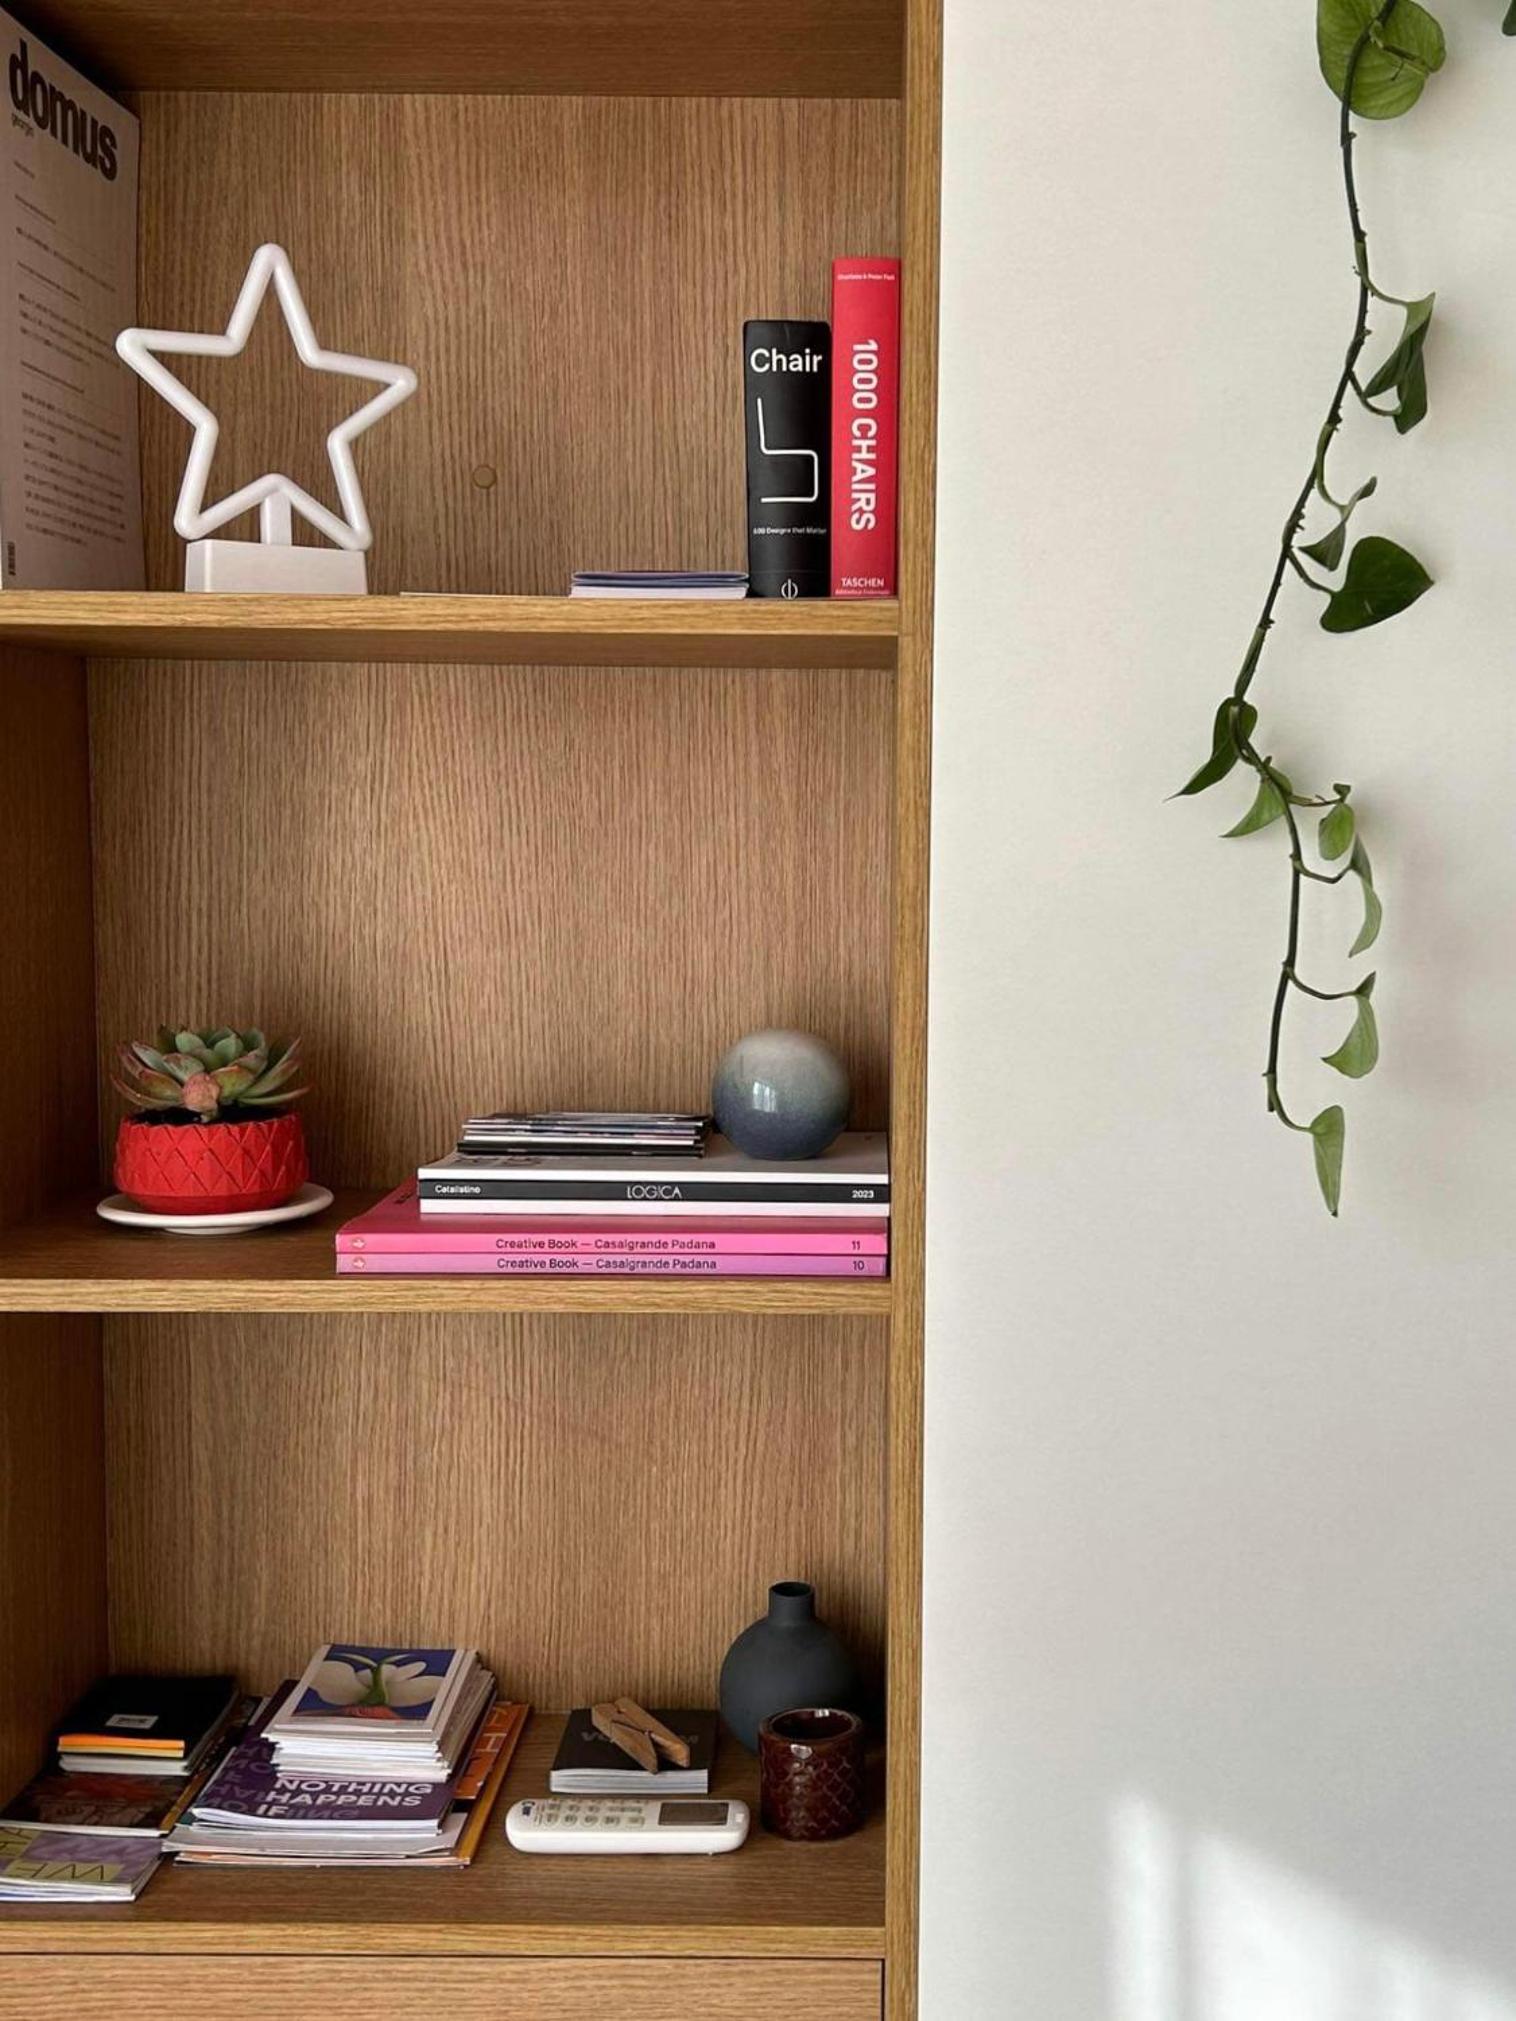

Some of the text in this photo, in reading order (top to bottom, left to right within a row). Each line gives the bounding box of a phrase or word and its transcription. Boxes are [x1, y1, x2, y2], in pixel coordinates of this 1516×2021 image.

[9, 38, 117, 181] domus
[750, 348, 822, 373] Chair
[851, 340, 878, 531] 1000 CHAIRS
[841, 577, 884, 588] TASCHEN
[627, 1186, 682, 1199] LOGICA
[852, 1190, 874, 1199] 2023
[496, 1238, 545, 1249] Creative
[548, 1239, 578, 1250] Book
[594, 1239, 669, 1252] Casalgrande
[671, 1239, 716, 1250] Padana
[852, 1241, 861, 1250] 11
[497, 1258, 546, 1269] Creative
[549, 1259, 579, 1269] Book
[596, 1259, 670, 1272] Casalgrande
[672, 1259, 717, 1270] Padana
[853, 1261, 864, 1271] 10
[273, 1778, 433, 1794] NOTHING
[265, 1791, 422, 1806] HAPPENS
[256, 1804, 288, 1817] IF
